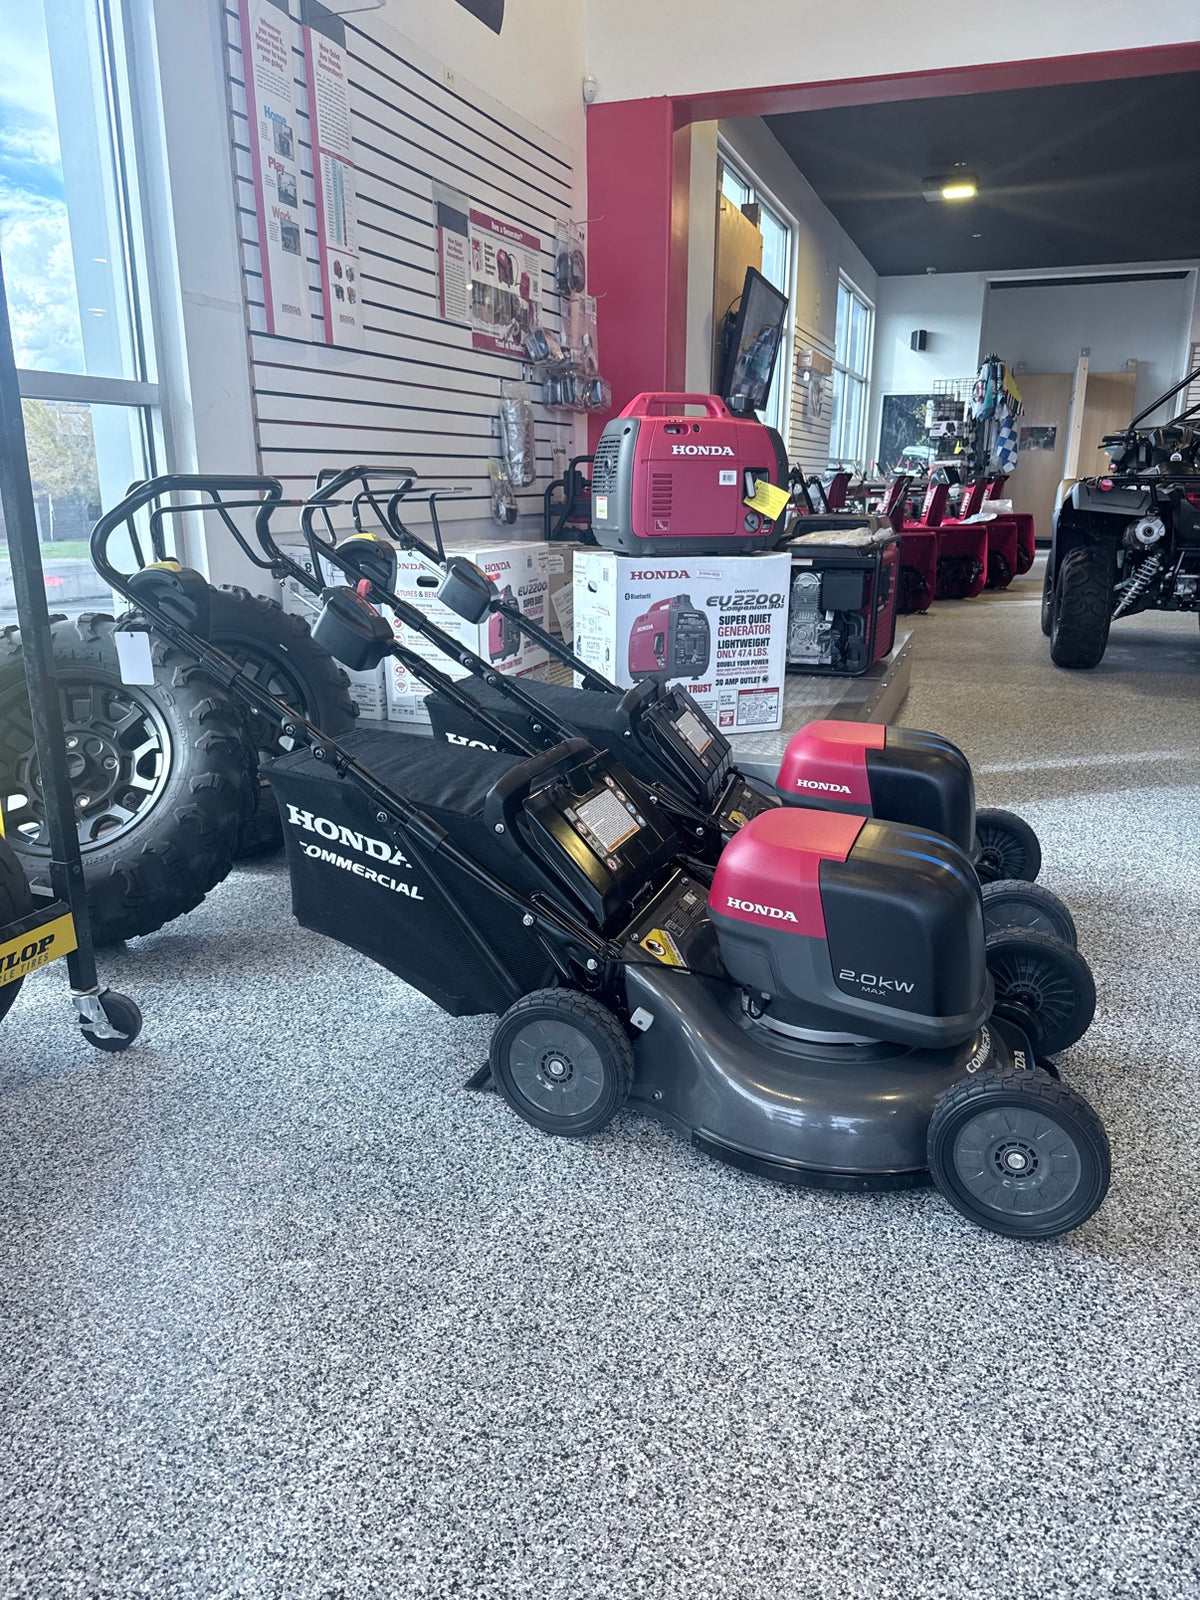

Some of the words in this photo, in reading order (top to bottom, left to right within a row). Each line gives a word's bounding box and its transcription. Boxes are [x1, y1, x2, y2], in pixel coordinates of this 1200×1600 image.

[264, 105, 287, 126] Home
[268, 156, 285, 174] Play
[272, 205, 292, 221] Work
[282, 303, 301, 315] HONDA
[672, 445, 735, 456] HONDA
[484, 561, 511, 573] HONDA
[629, 570, 691, 580] HONDA
[523, 597, 535, 608] SUPER
[535, 595, 544, 605] QUIET
[720, 604, 767, 612] Companion
[719, 615, 746, 625] SUPER
[748, 614, 772, 625] QUIET
[636, 624, 654, 632] HONDA
[717, 625, 771, 637] GENERATOR
[718, 638, 770, 649] LIGHTWEIGHT
[717, 649, 737, 659] ONLY
[738, 649, 752, 657] 47.4
[753, 648, 769, 656] LBS.
[717, 660, 736, 668] DOUBLE
[740, 676, 761, 684] OUTLET
[688, 684, 712, 693] TRUST
[796, 778, 851, 793] HONDA
[286, 803, 413, 869] HONDA
[727, 897, 798, 922] HONDA
[21, 952, 49, 973] TIRES
[839, 968, 915, 994] 2.0kW
[861, 985, 887, 996] MAX
